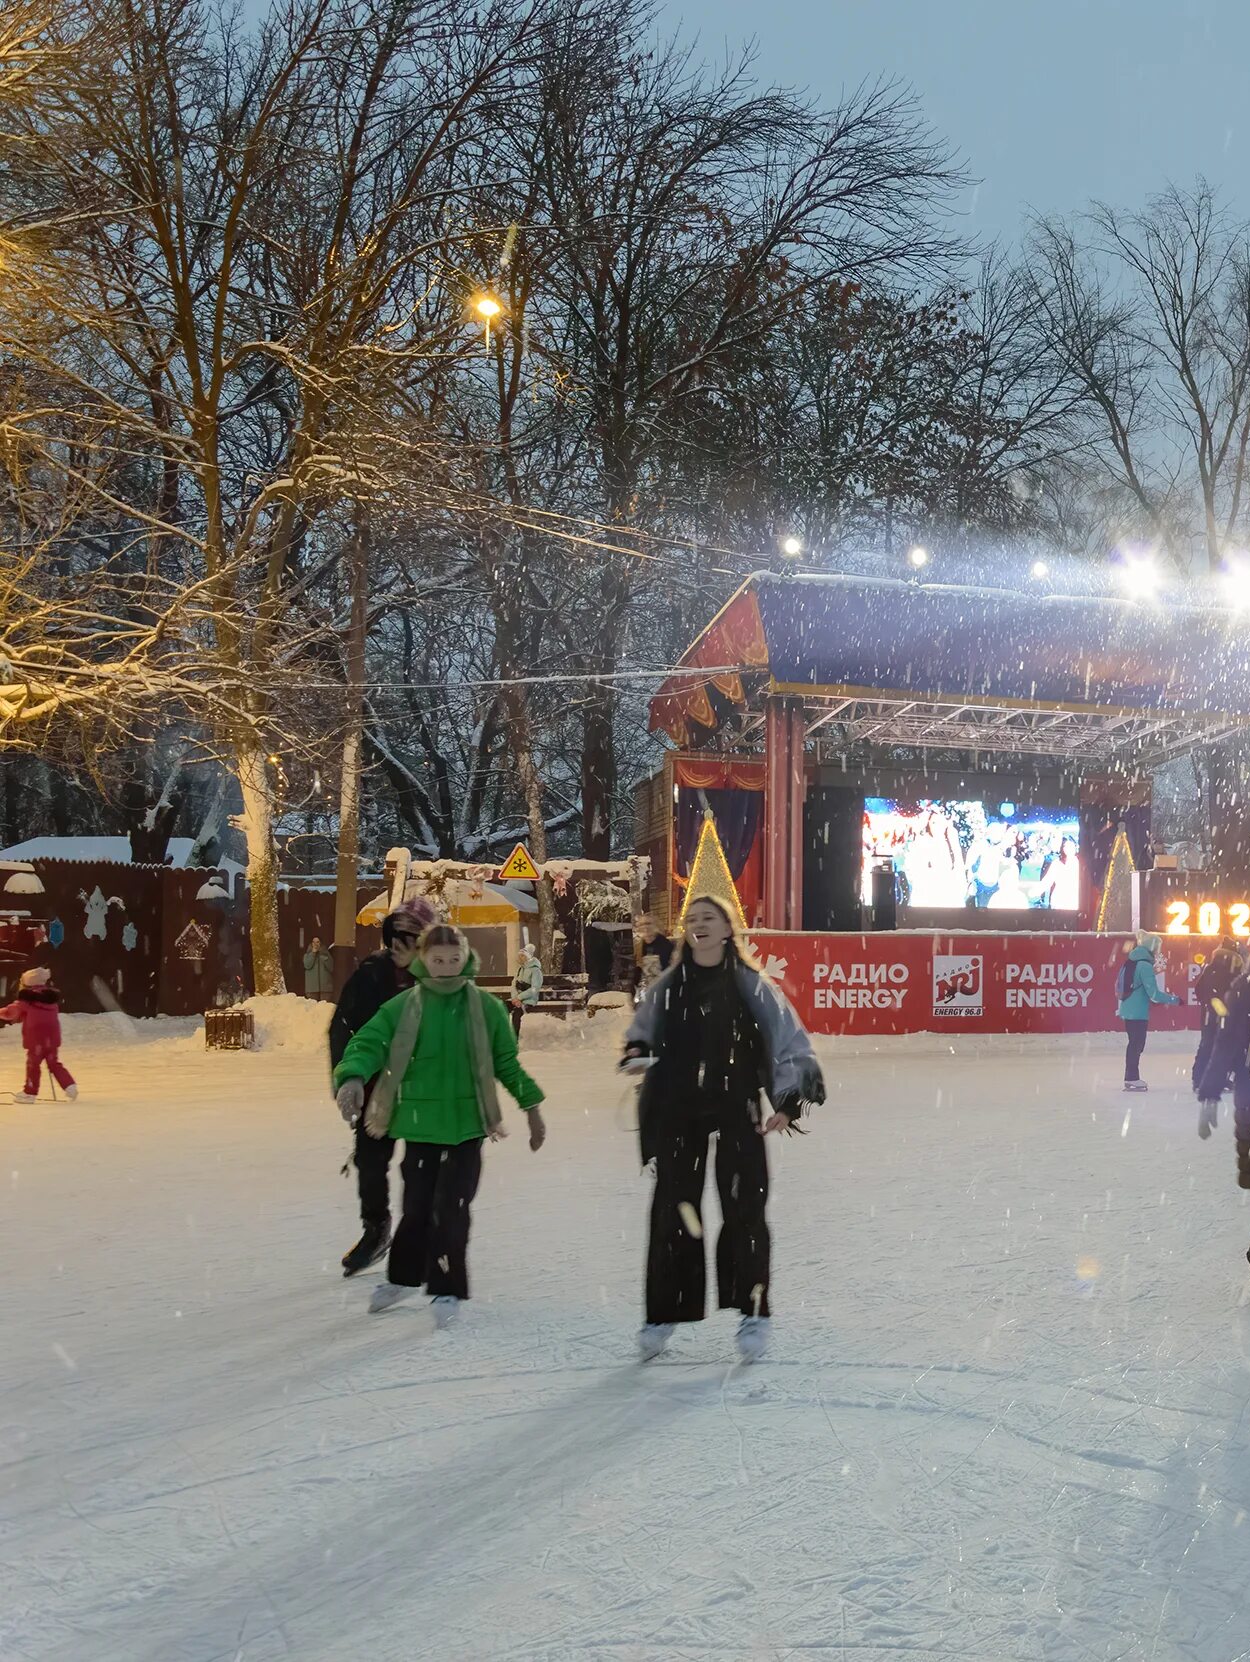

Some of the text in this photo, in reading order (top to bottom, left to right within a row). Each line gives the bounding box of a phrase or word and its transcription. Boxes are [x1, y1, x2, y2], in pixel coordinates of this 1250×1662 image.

[814, 963, 909, 986] РАДИО
[936, 958, 980, 1002] NRJ
[1005, 963, 1094, 986] РАДИО
[814, 988, 908, 1009] ENERGY
[1005, 988, 1093, 1008] ENERGY
[934, 1008, 963, 1016] ENERGY
